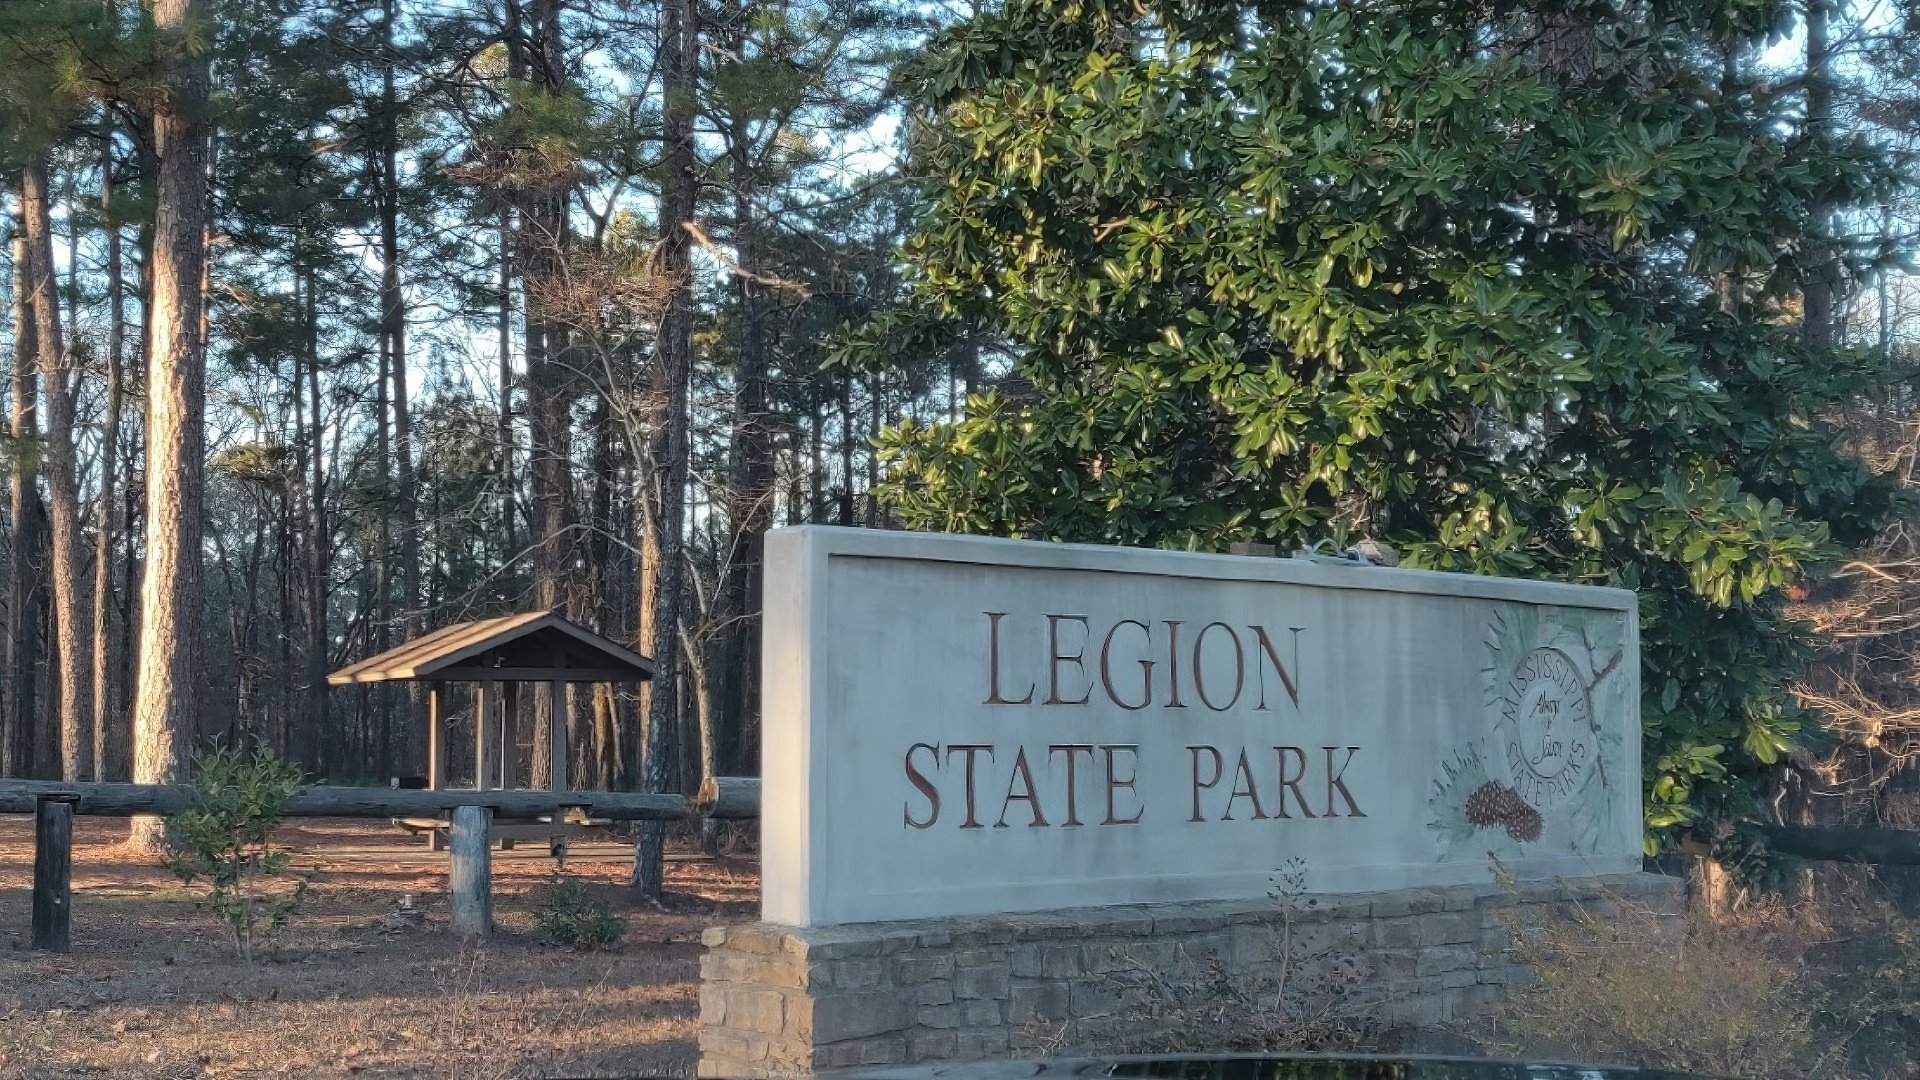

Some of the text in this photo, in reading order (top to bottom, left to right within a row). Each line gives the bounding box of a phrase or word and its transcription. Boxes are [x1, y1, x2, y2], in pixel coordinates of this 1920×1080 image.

[982, 611, 1306, 712] LEGION
[1503, 653, 1585, 724] MISSISSIPPI
[904, 741, 1368, 830] STATE PARK
[1507, 742, 1543, 807] STATE
